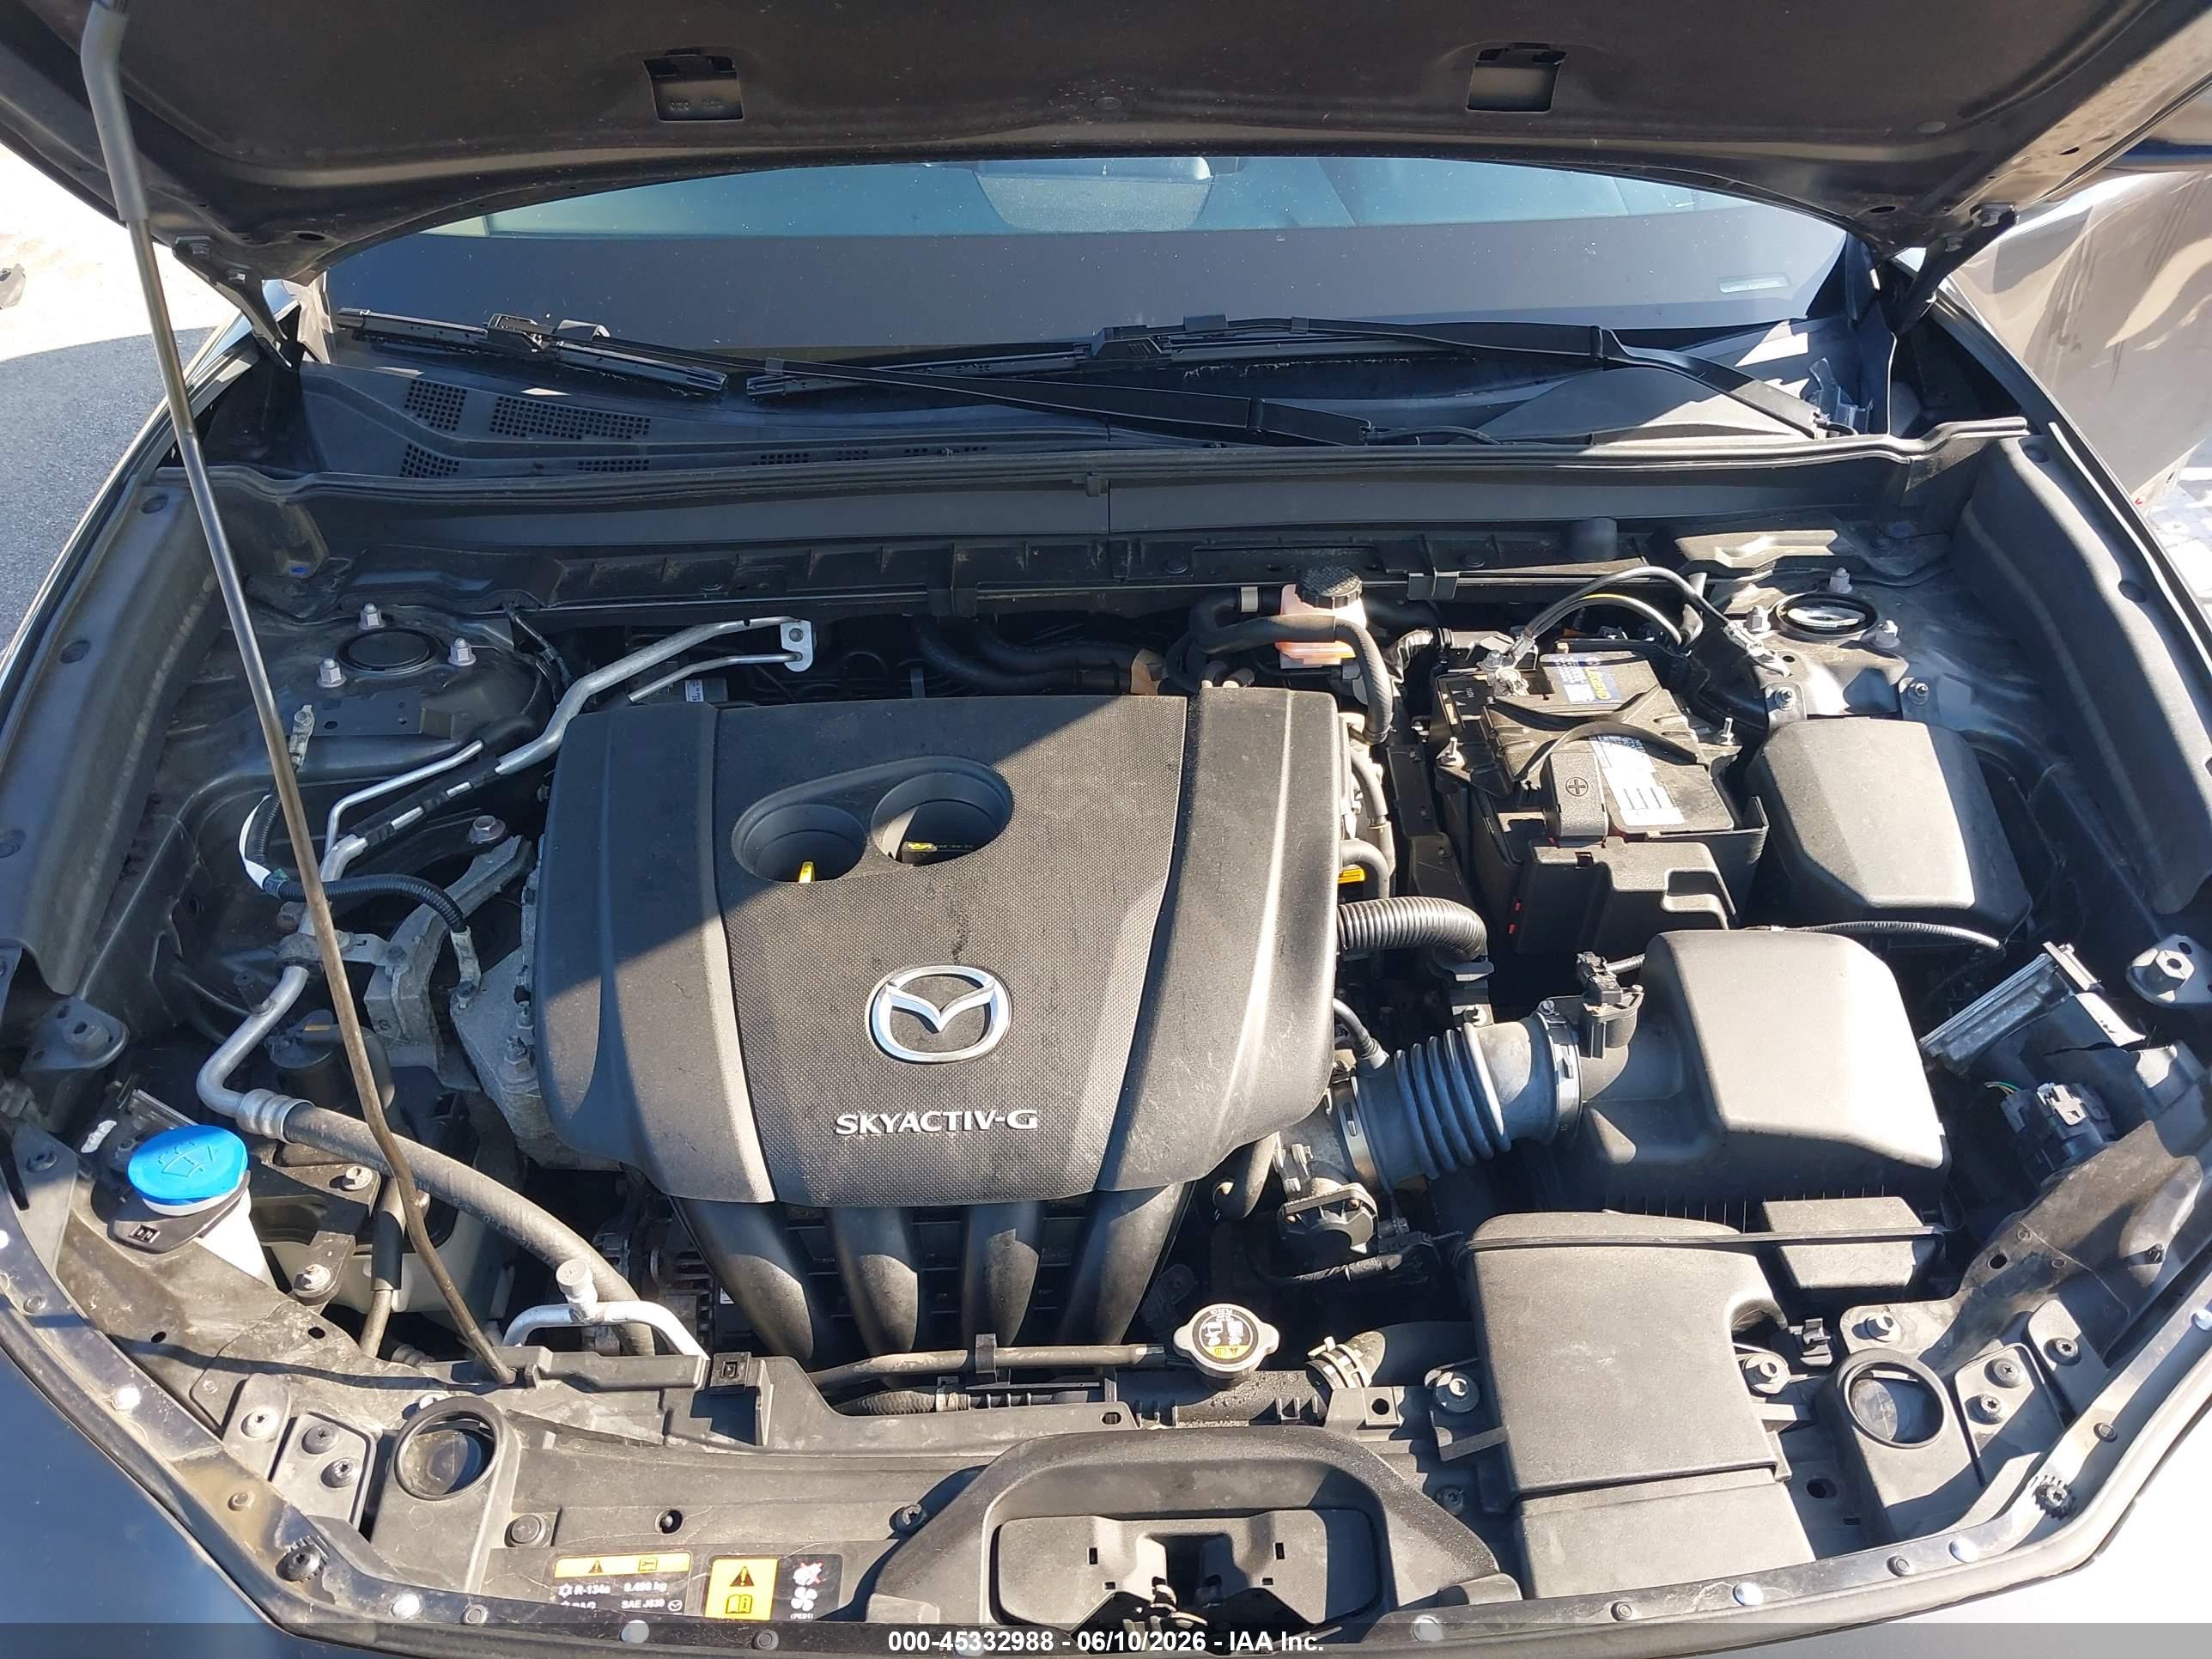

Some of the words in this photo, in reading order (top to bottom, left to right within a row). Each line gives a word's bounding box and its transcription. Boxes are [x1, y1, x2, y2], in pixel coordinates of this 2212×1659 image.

[1585, 666, 1611, 700] LEGEND
[835, 1109, 1038, 1135] SKYACTIV-G
[621, 1599, 641, 1609] SAE
